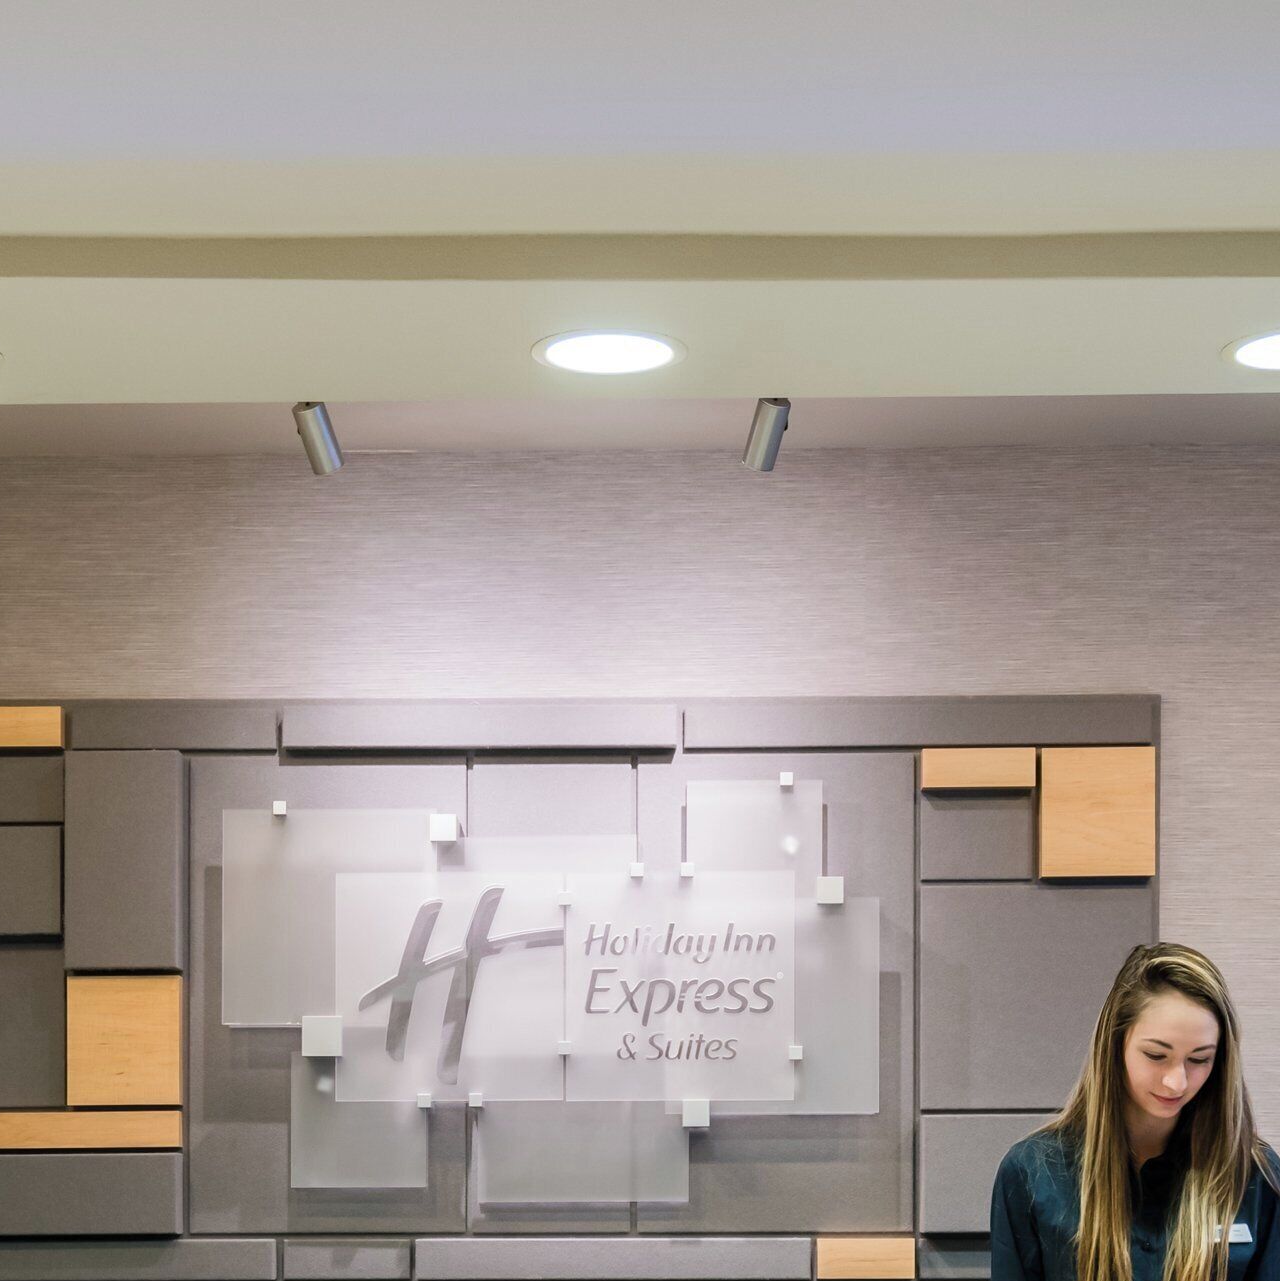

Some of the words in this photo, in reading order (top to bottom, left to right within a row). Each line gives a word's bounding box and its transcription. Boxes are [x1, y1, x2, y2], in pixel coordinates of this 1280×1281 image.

[583, 922, 717, 964] Holiday
[723, 922, 776, 953] Inn
[584, 967, 776, 1027] Express
[616, 1032, 636, 1061] &
[646, 1032, 738, 1061] Suites
